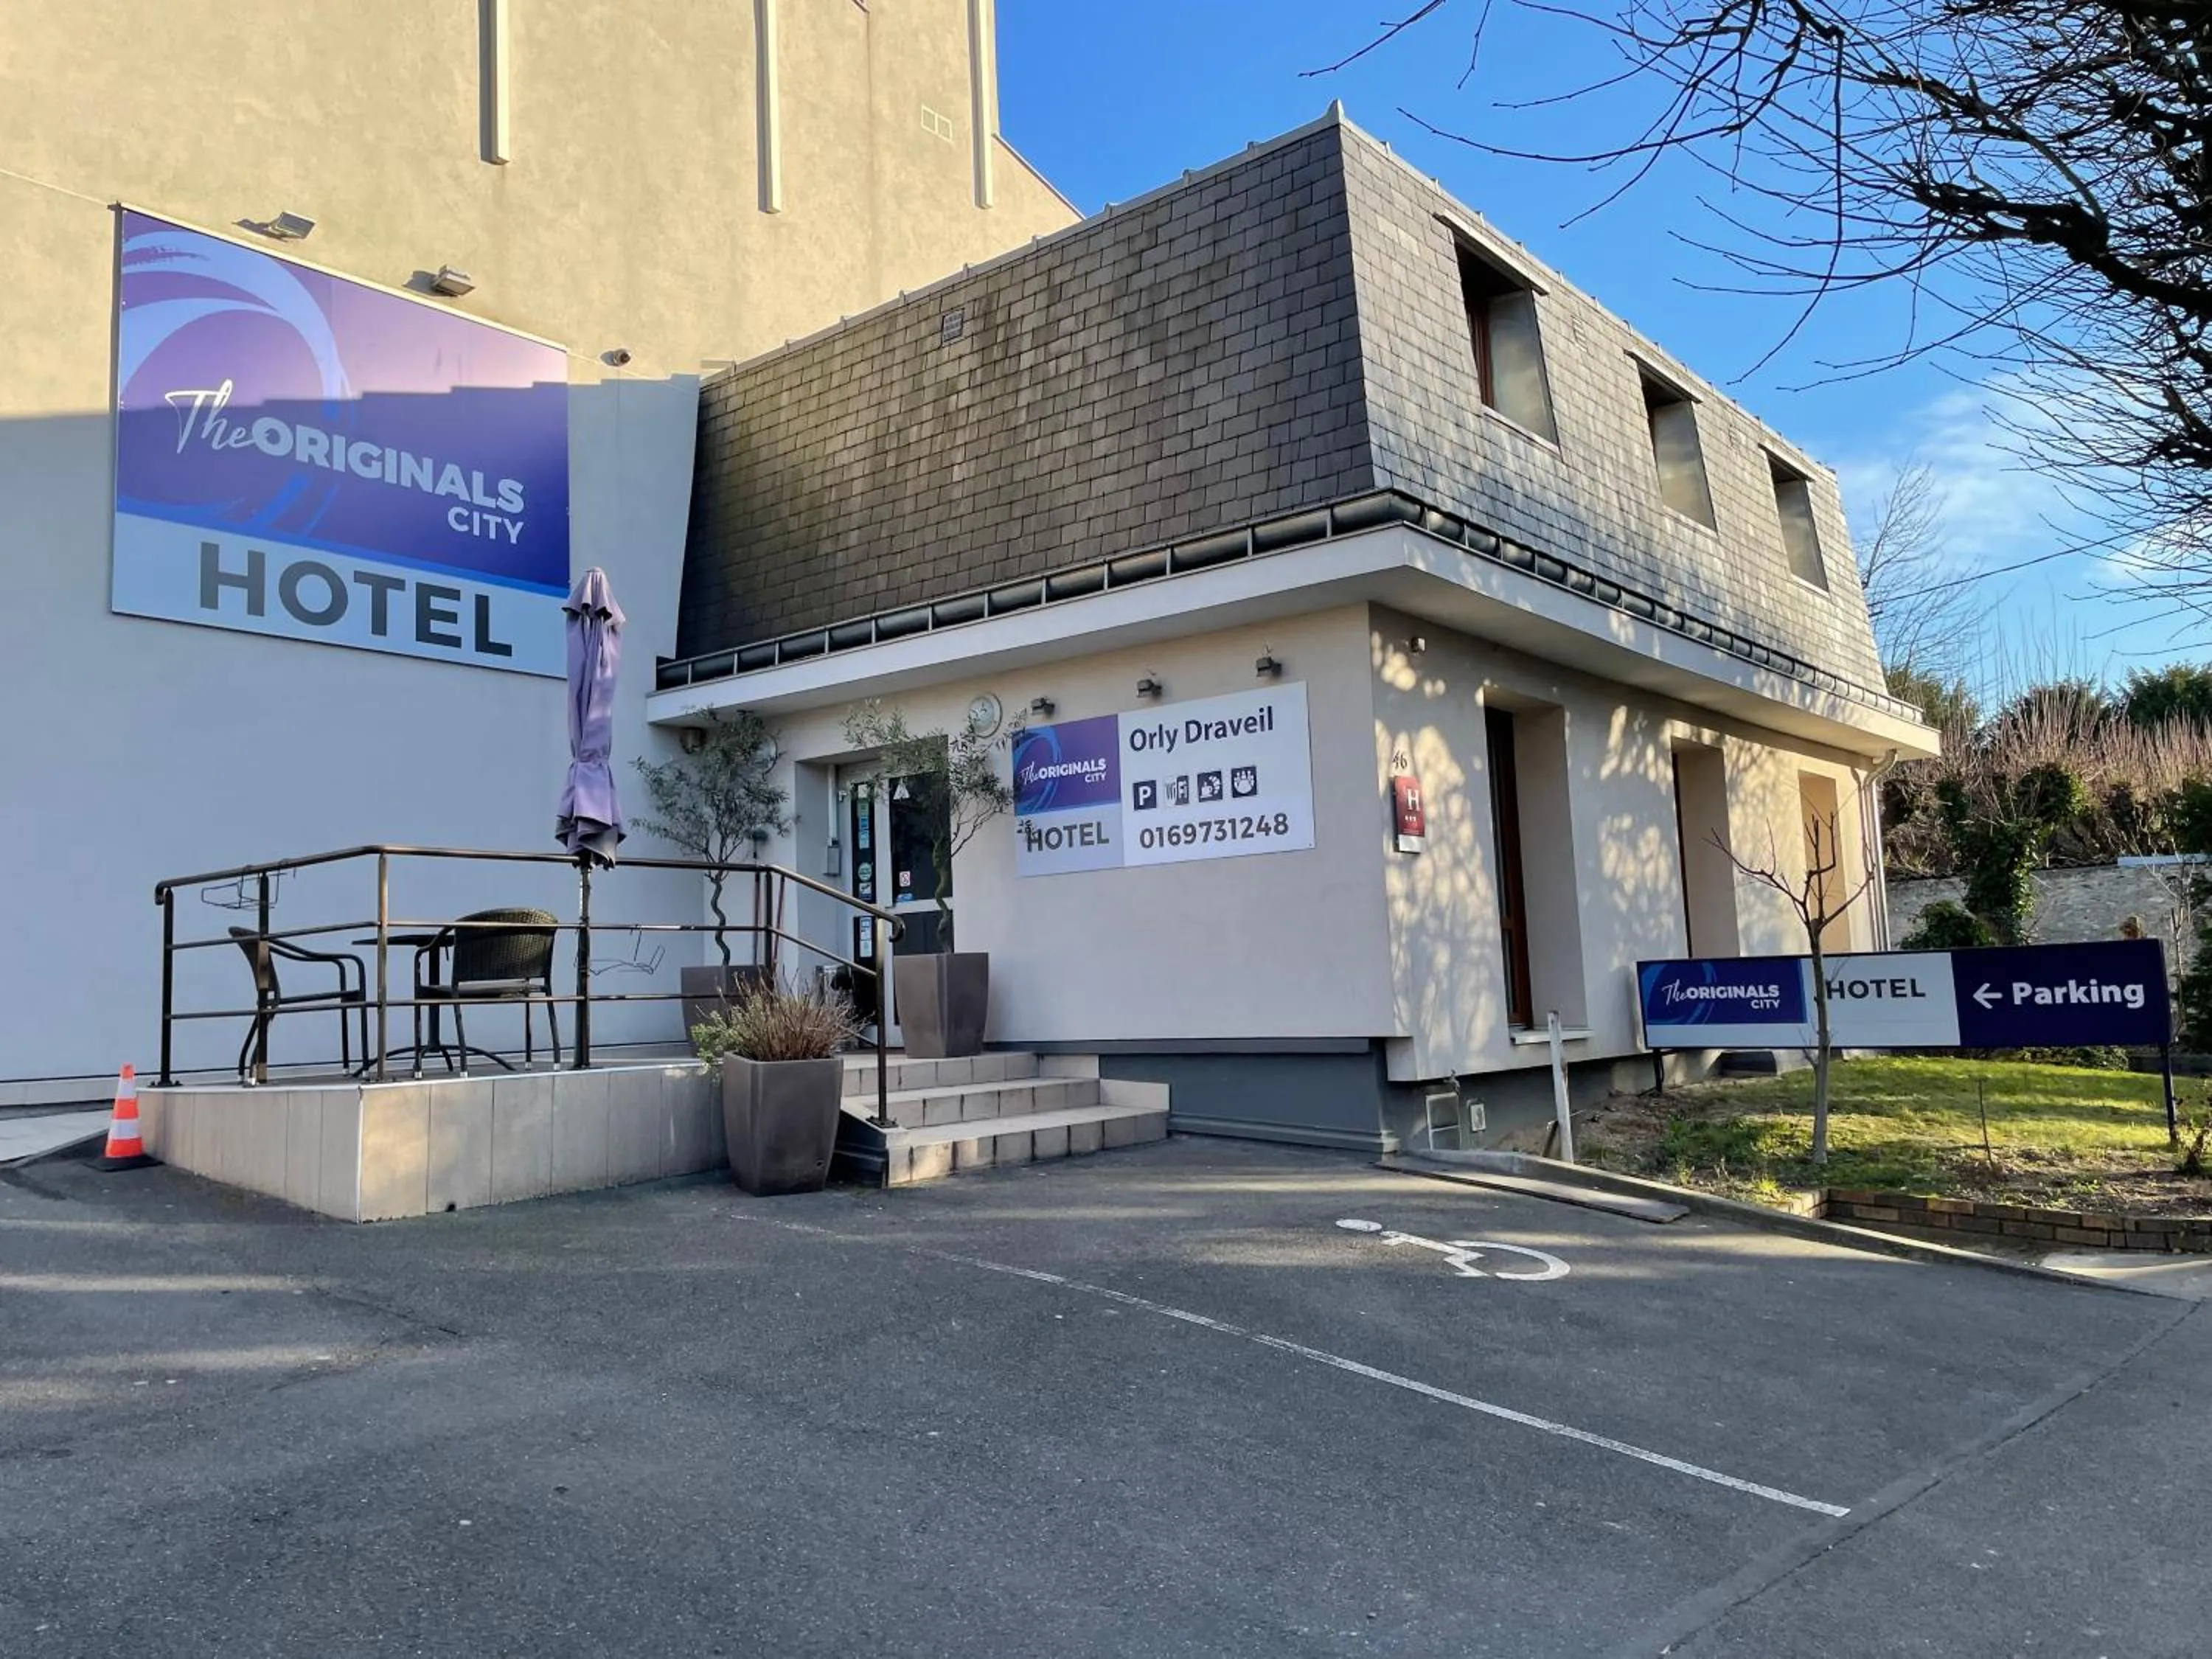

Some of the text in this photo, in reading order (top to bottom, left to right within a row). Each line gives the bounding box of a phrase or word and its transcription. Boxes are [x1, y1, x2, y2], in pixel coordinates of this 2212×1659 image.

[448, 507, 525, 545] CITY
[200, 542, 512, 657] HOTEL
[1130, 706, 1273, 753] Orly Draveil
[1085, 771, 1107, 783] CITY
[1026, 821, 1110, 852] HOTEL
[1140, 813, 1289, 849] 0169731248
[1750, 999, 1781, 1009] CITY
[1825, 978, 1926, 999] HOTEL
[2012, 978, 2145, 1009] Parking
